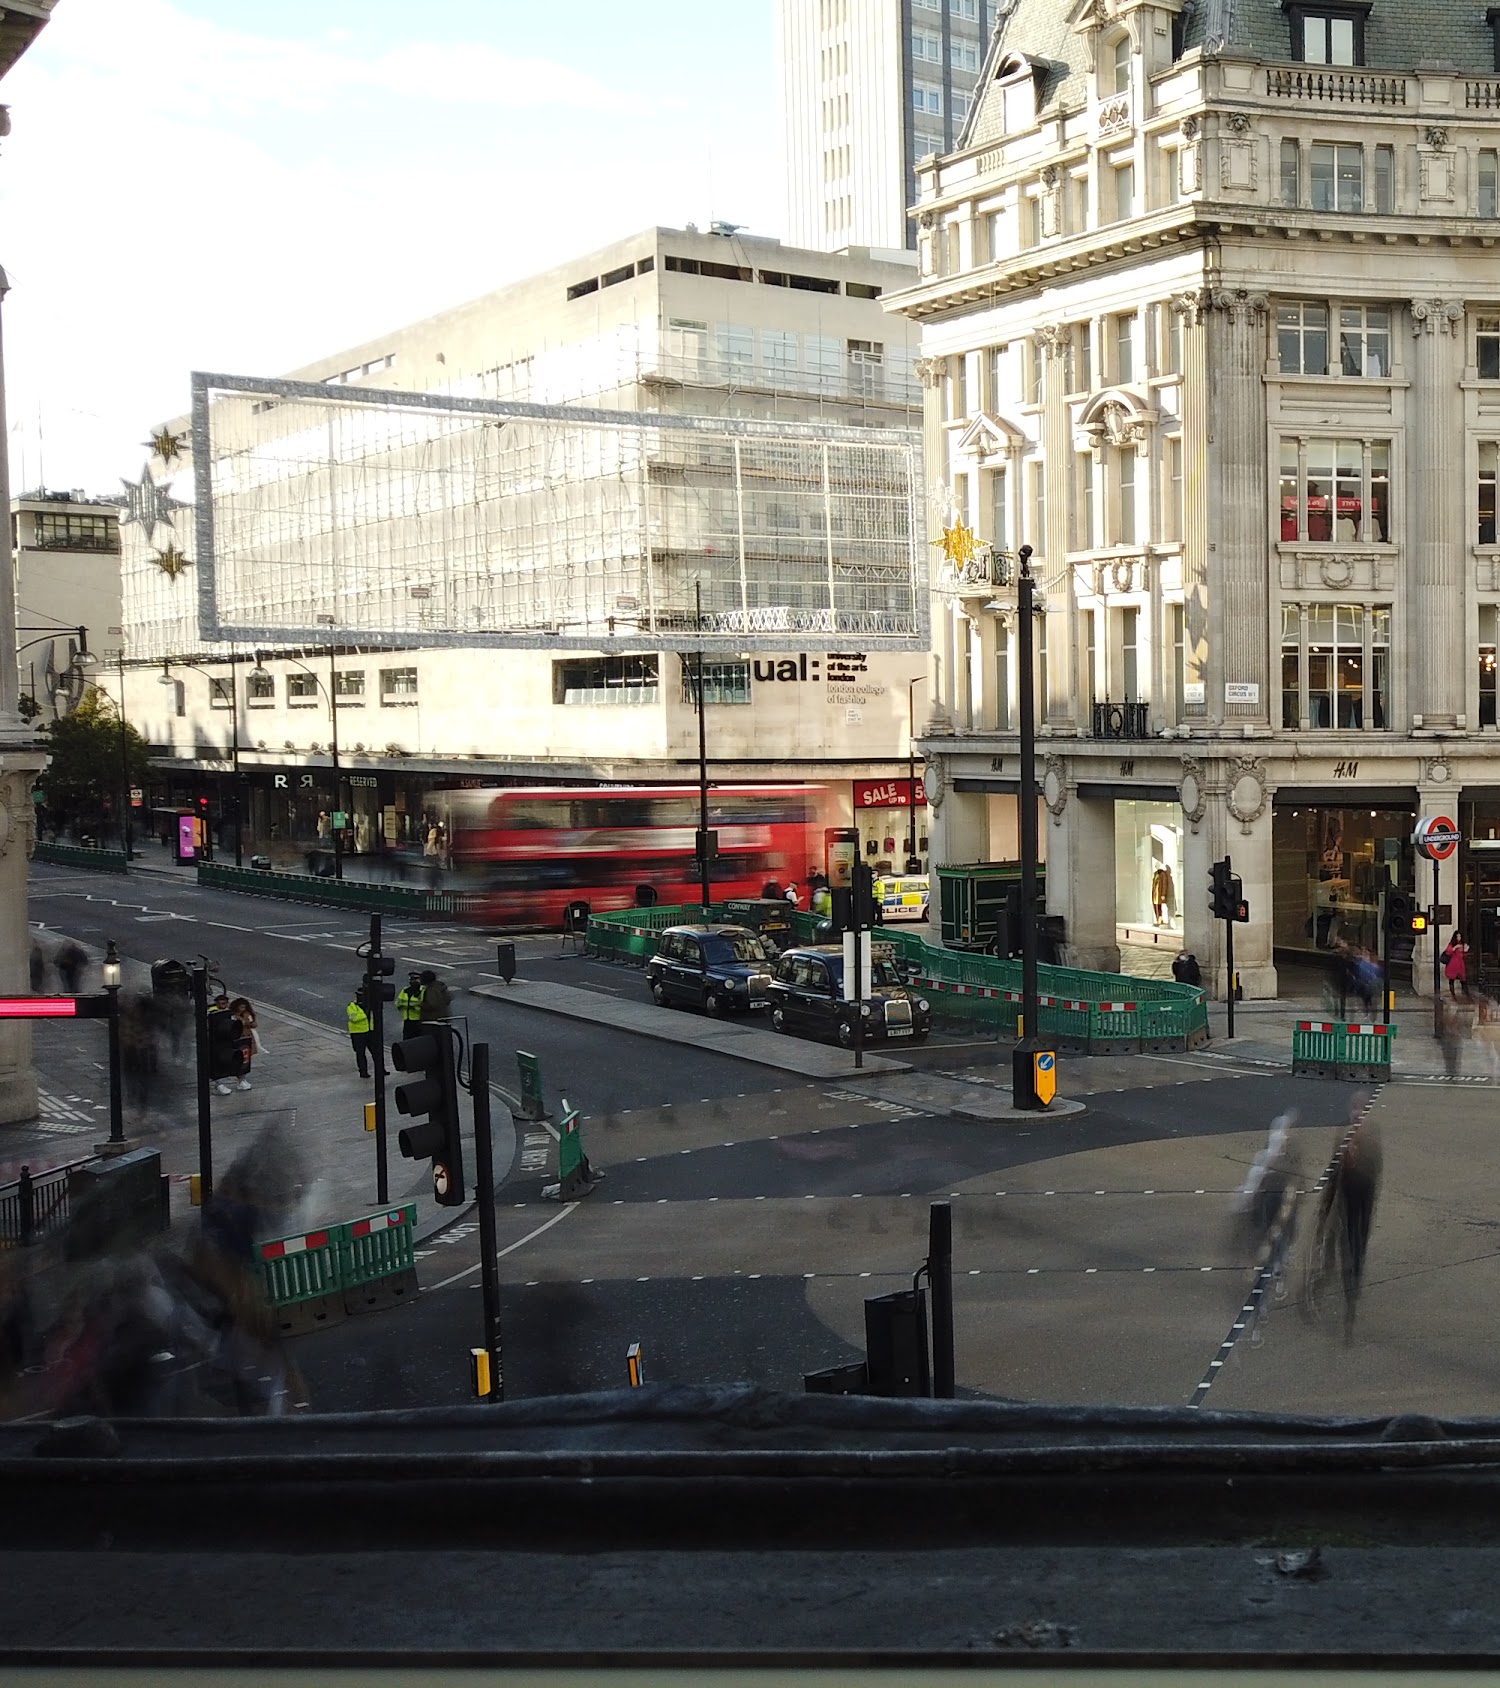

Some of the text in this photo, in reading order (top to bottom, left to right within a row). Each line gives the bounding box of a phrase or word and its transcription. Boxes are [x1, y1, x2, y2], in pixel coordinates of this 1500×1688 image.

[754, 653, 820, 682] ual:
[827, 662, 868, 671] of the arts
[827, 672, 856, 682] london
[1119, 760, 1135, 777] H&M
[1333, 761, 1359, 779] H&M
[275, 774, 289, 788] R
[863, 783, 897, 805] SALE
[914, 786, 926, 799] 5
[1423, 831, 1460, 844] UNDERGROUND
[728, 902, 751, 911] CONWAY
[429, 1222, 480, 1245] LOOK
